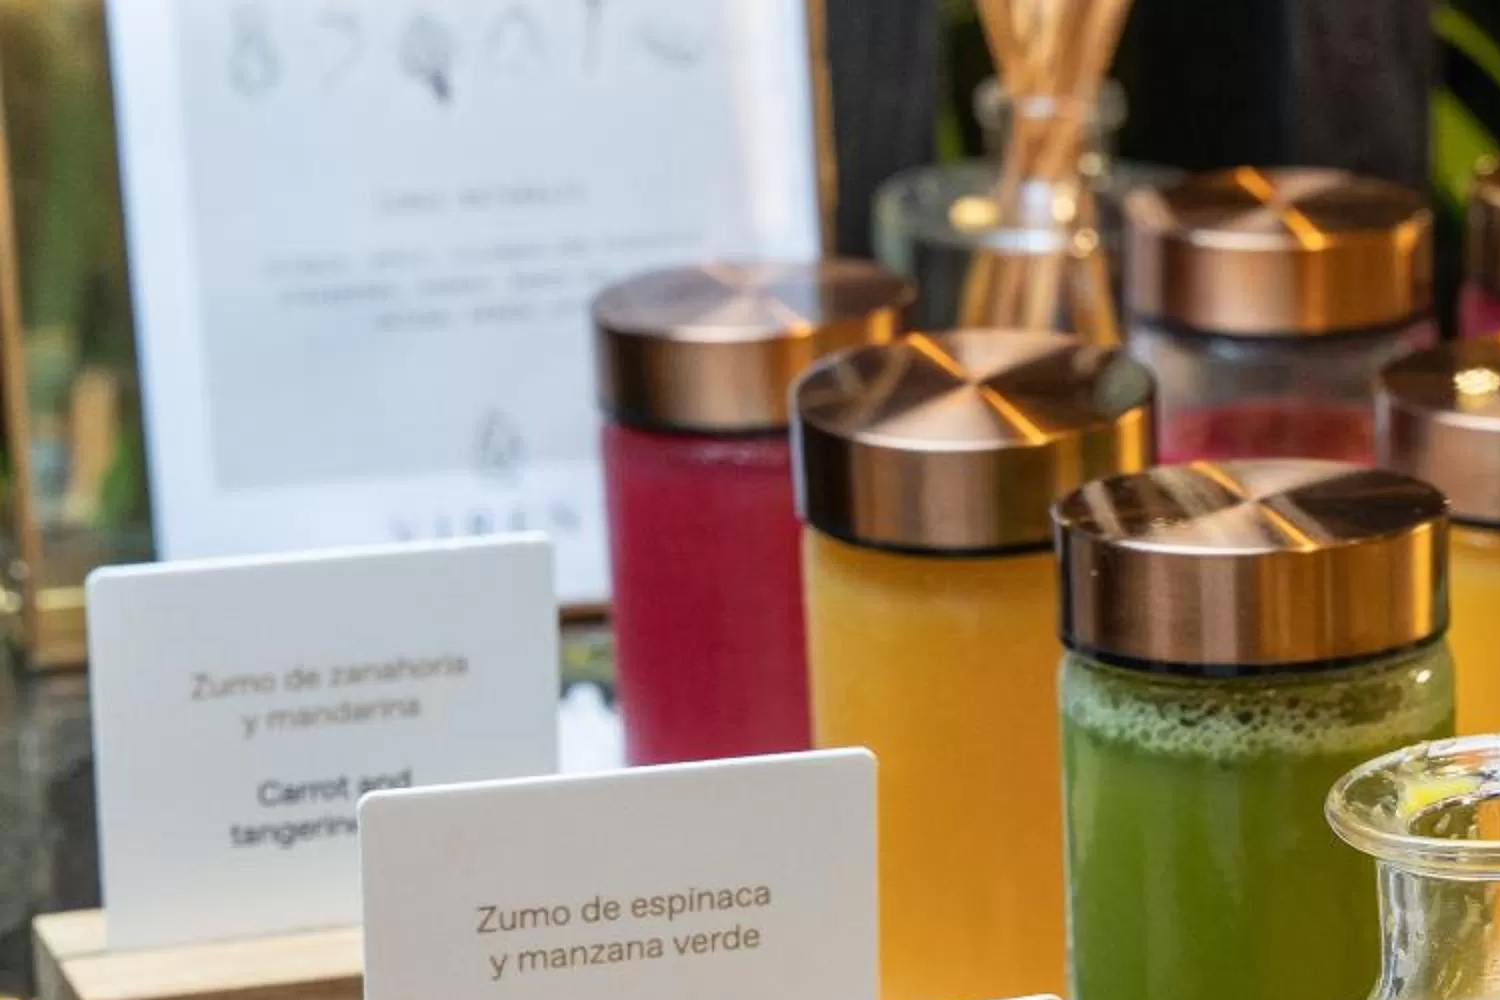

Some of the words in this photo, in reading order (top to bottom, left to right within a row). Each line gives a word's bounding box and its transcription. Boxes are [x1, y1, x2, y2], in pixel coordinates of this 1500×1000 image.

[190, 670, 276, 701] Zumo
[284, 666, 320, 692] de
[329, 654, 468, 688] zanahoria
[241, 712, 257, 740] y
[265, 698, 421, 731] mandarina
[257, 775, 348, 808] Carrot
[476, 905, 571, 934] Zumo
[580, 896, 621, 924] de
[631, 884, 772, 920] espinaca
[489, 954, 508, 981] y
[517, 936, 664, 973] manzana
[673, 924, 761, 956] verde
